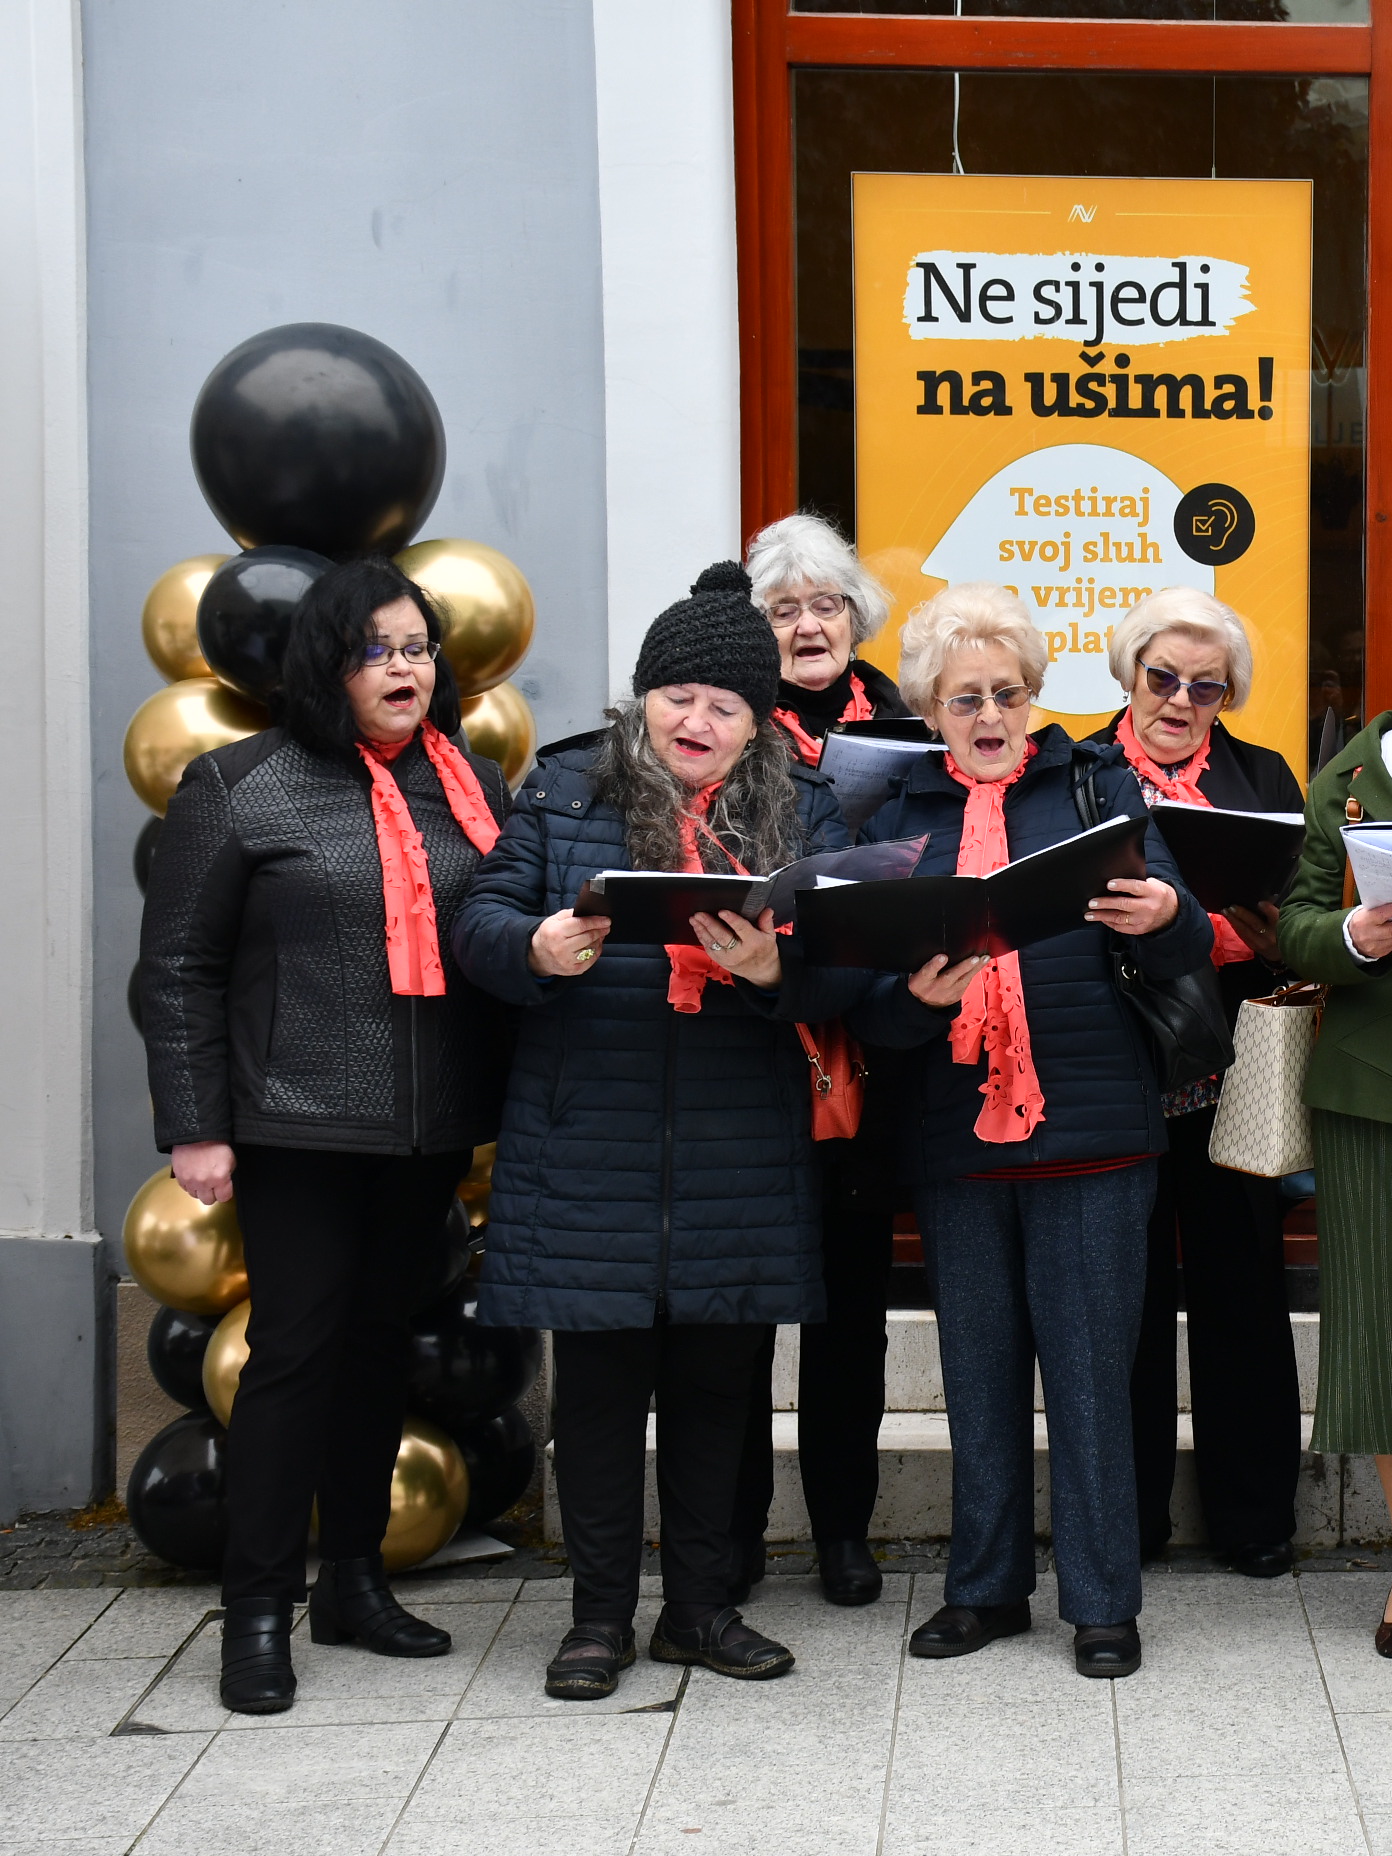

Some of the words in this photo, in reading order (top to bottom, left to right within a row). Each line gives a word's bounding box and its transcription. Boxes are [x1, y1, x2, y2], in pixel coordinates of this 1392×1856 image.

[915, 262, 1015, 325] Ne
[1032, 261, 1217, 347] sijedi
[916, 366, 1013, 417] na
[1024, 350, 1275, 421] ušima!
[1009, 486, 1151, 527] Testiraj
[998, 531, 1072, 572] svoj
[1082, 531, 1163, 564] sluh
[1031, 577, 1168, 618] vrijem
